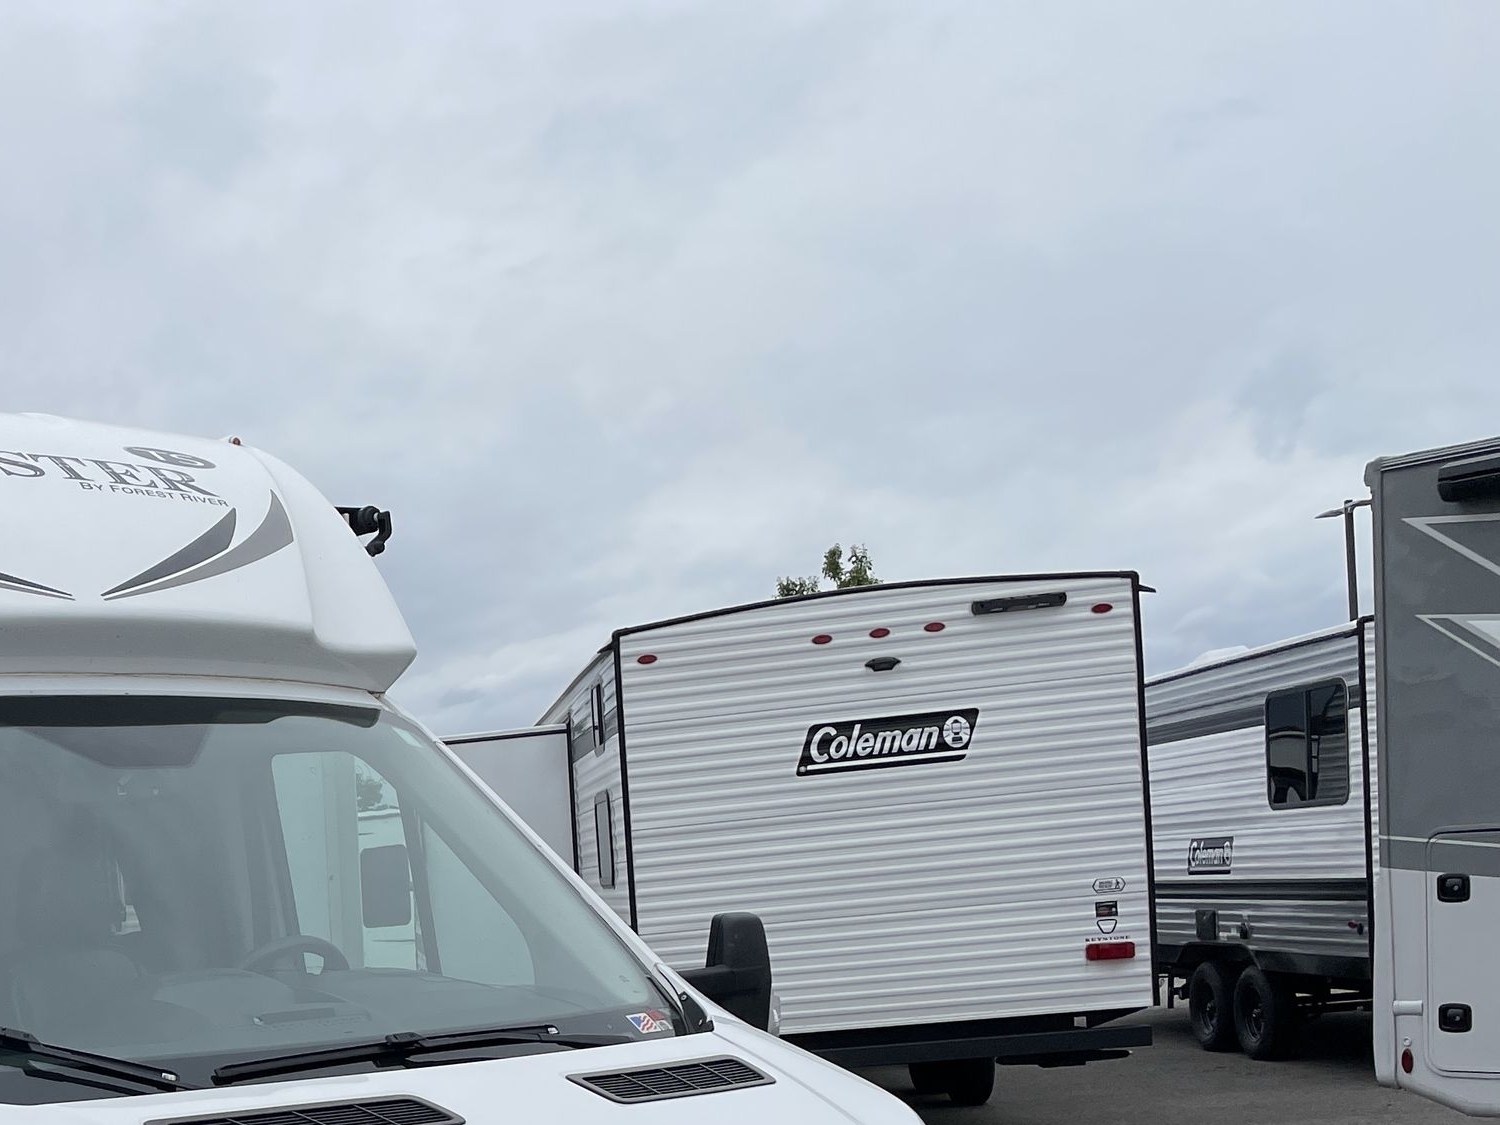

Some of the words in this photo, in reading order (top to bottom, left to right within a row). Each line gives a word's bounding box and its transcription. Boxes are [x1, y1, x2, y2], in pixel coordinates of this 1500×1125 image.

[109, 484, 175, 500] FOREST
[180, 493, 230, 507] RIVER
[809, 723, 940, 763] Coleman
[1190, 841, 1224, 867] Coleman
[1085, 934, 1132, 942] KEYSTONE
